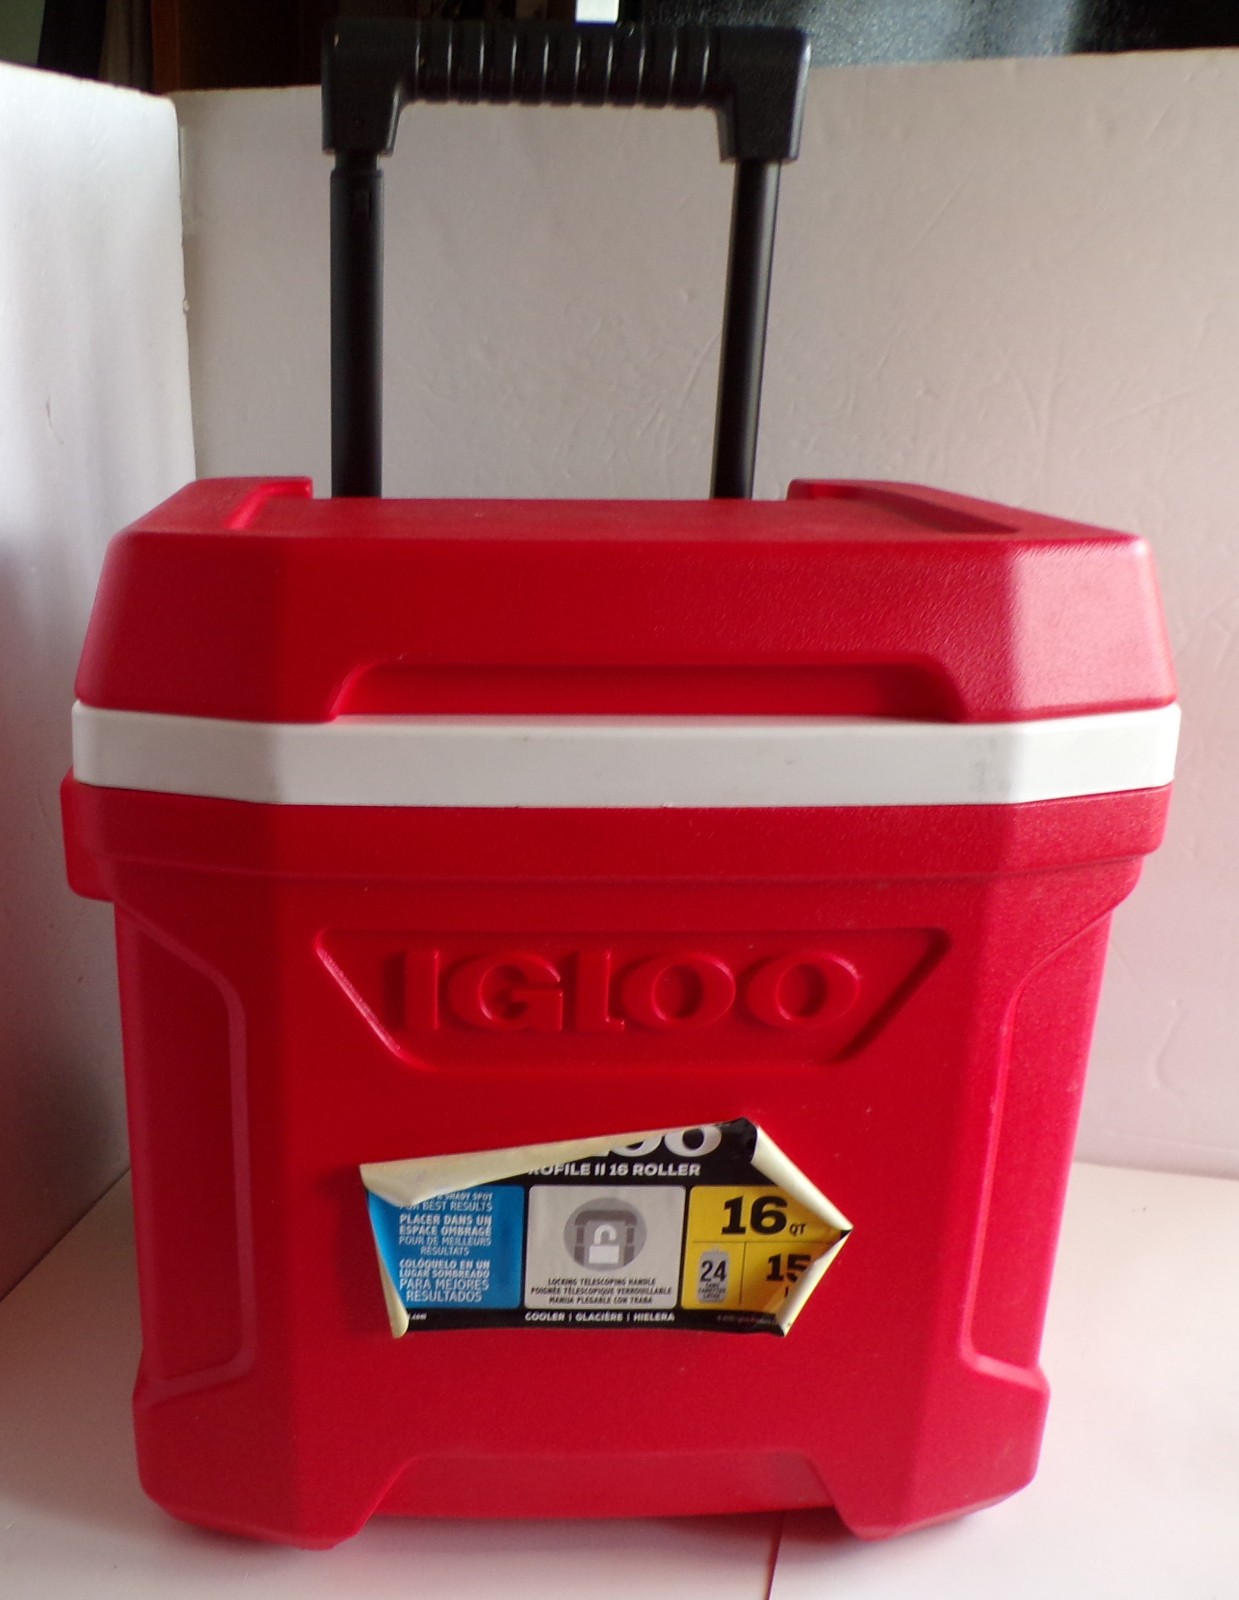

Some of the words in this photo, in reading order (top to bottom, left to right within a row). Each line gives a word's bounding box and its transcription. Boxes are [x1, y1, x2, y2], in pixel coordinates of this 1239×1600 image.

[402, 948, 860, 1031] IGLOO
[609, 1162, 629, 1176] 16
[632, 1163, 702, 1177] ROLLER
[422, 1201, 447, 1211] BEST
[449, 1201, 493, 1213] RESULTS
[400, 1214, 440, 1225] PLACER
[443, 1214, 473, 1225] DANS
[475, 1215, 493, 1226] UN
[721, 1195, 788, 1236] 16
[789, 1223, 806, 1237] QT
[399, 1225, 438, 1236] ESPACE
[399, 1236, 424, 1246] POUR
[426, 1236, 439, 1247] DE
[475, 1259, 491, 1270] UN
[399, 1268, 430, 1279] LUGAR
[700, 1260, 727, 1282] 24
[400, 1279, 431, 1290] PARA
[434, 1279, 490, 1291] MEJORES
[406, 1290, 483, 1303] RESULTADOS
[524, 1311, 565, 1322] COOLER
[632, 1311, 676, 1323] HIELERA
